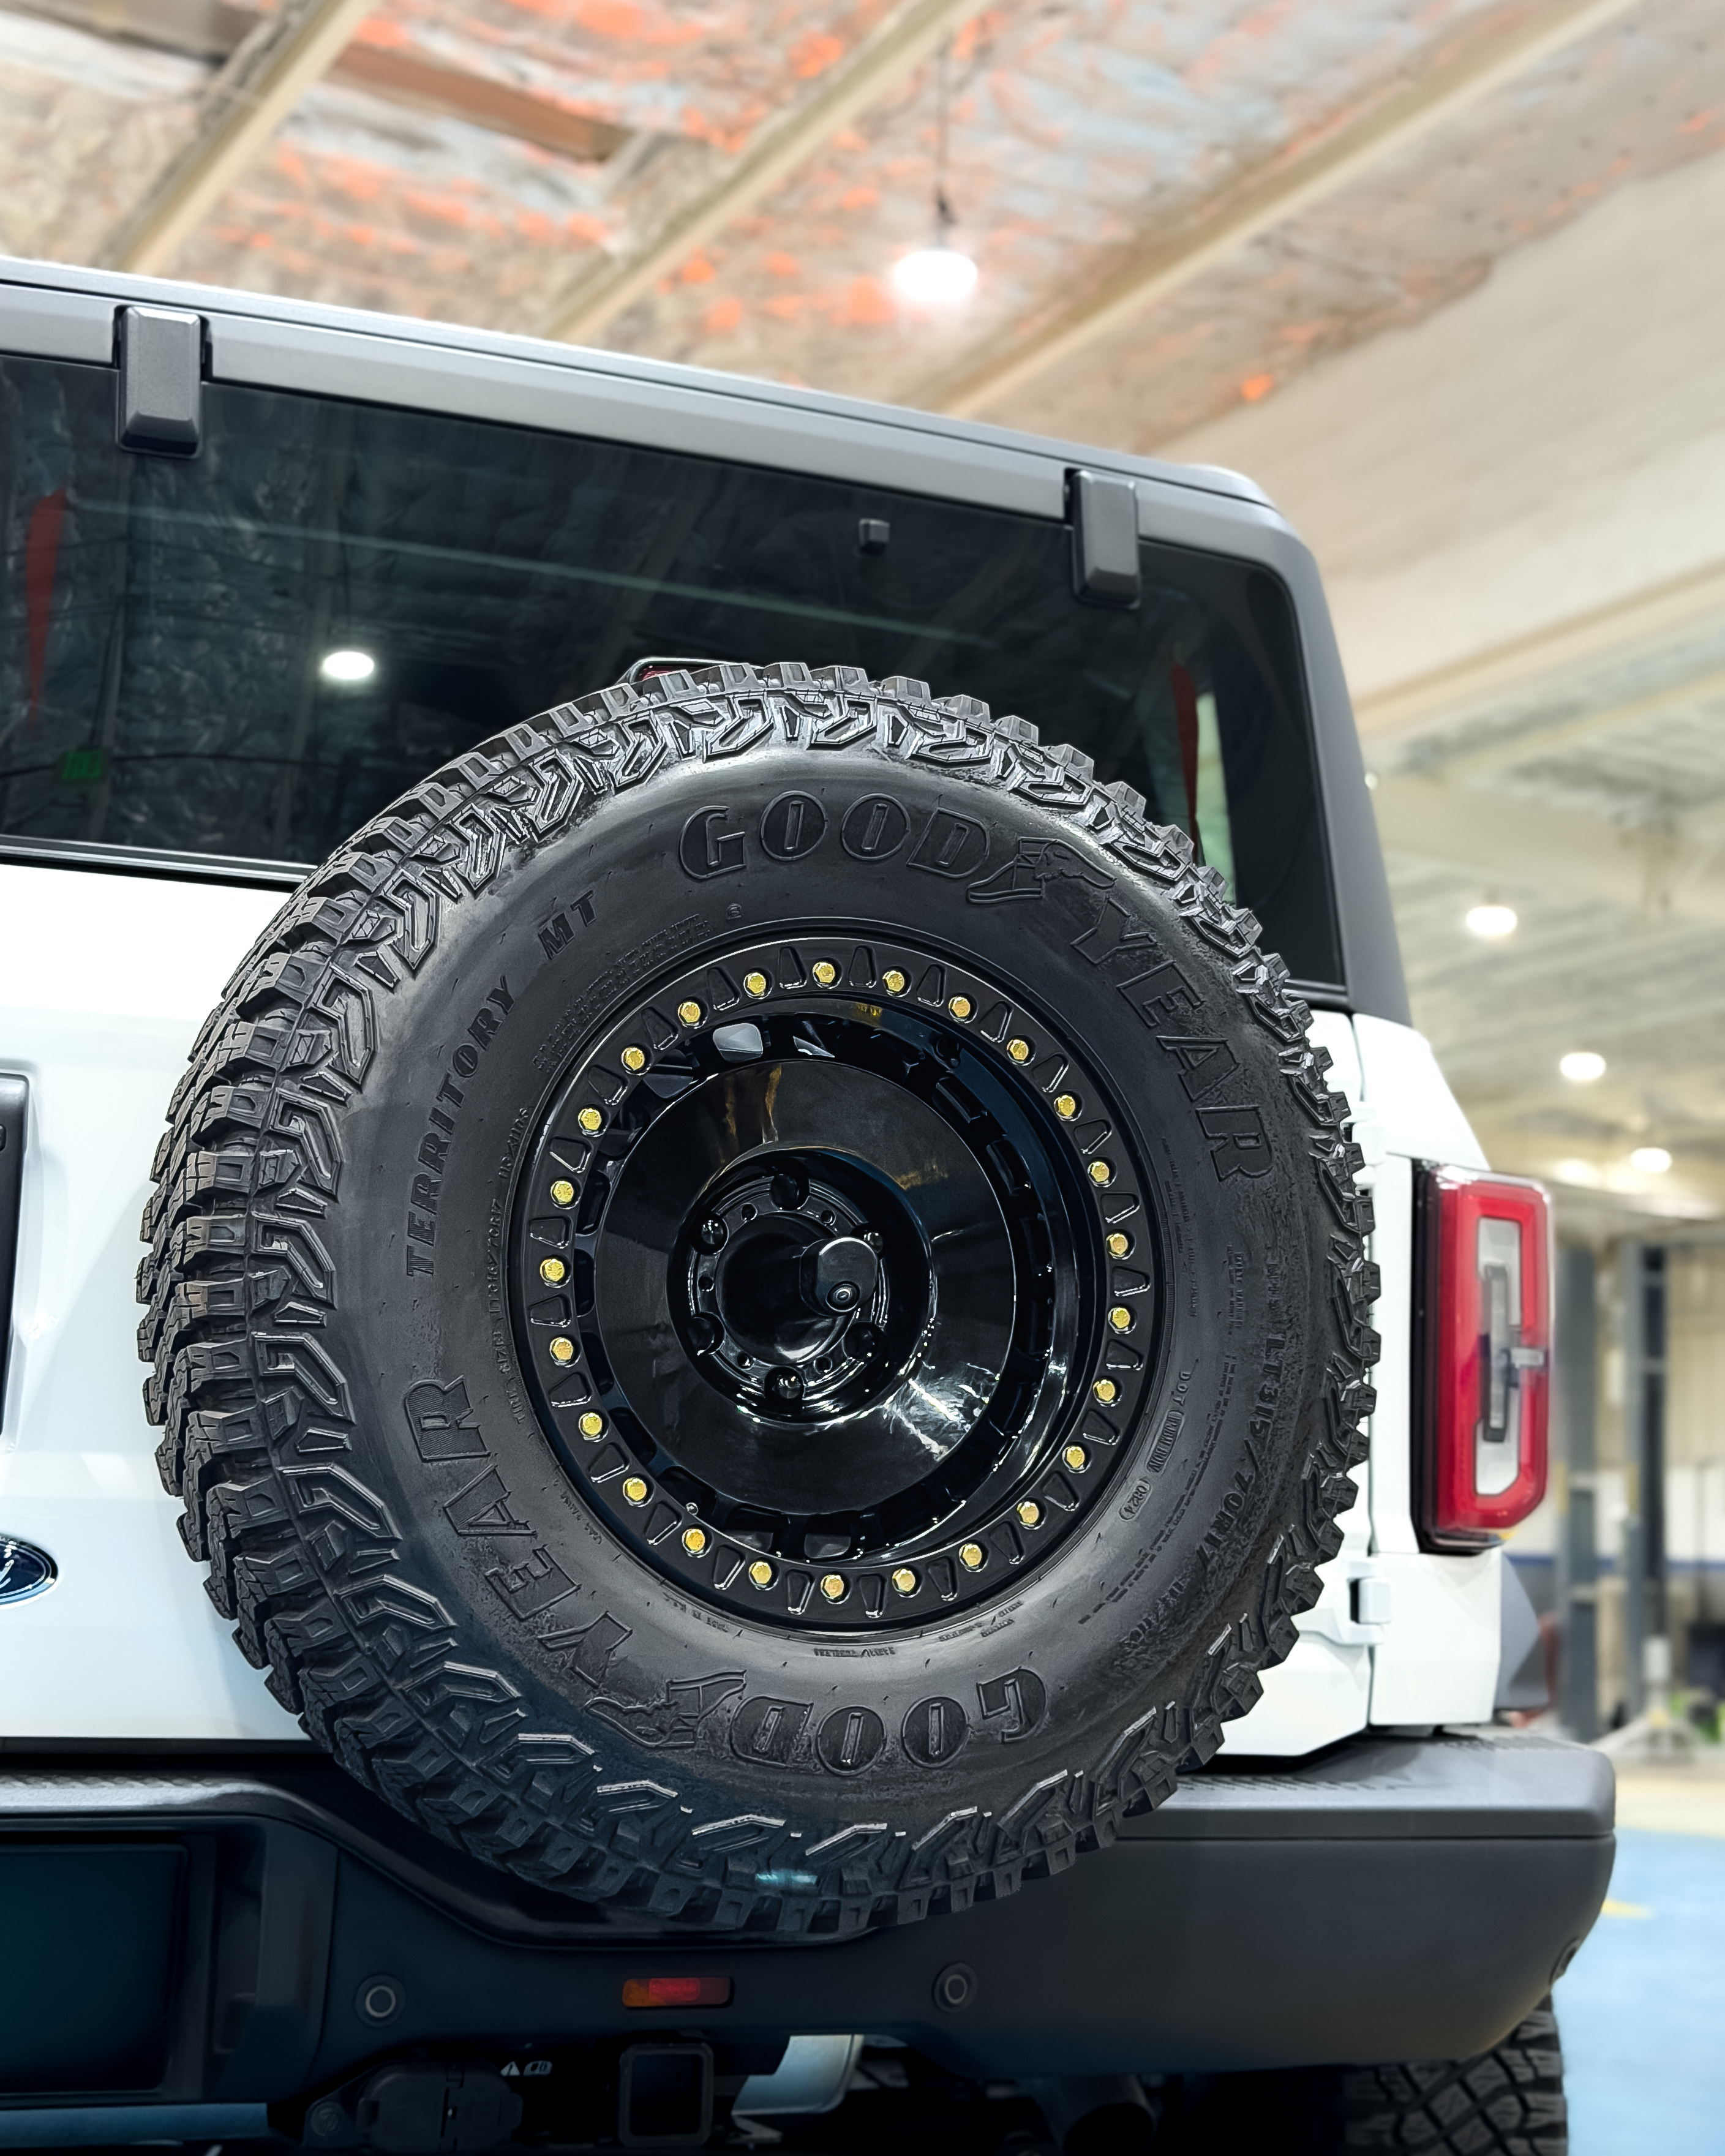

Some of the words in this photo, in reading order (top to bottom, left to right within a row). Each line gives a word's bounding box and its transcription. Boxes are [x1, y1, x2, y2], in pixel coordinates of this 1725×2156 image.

[406, 975, 516, 1277] TERRITORY
[538, 889, 596, 961] MT
[1173, 1370, 1192, 1407] DOT
[1195, 1337, 1285, 1571] LT315/70R17
